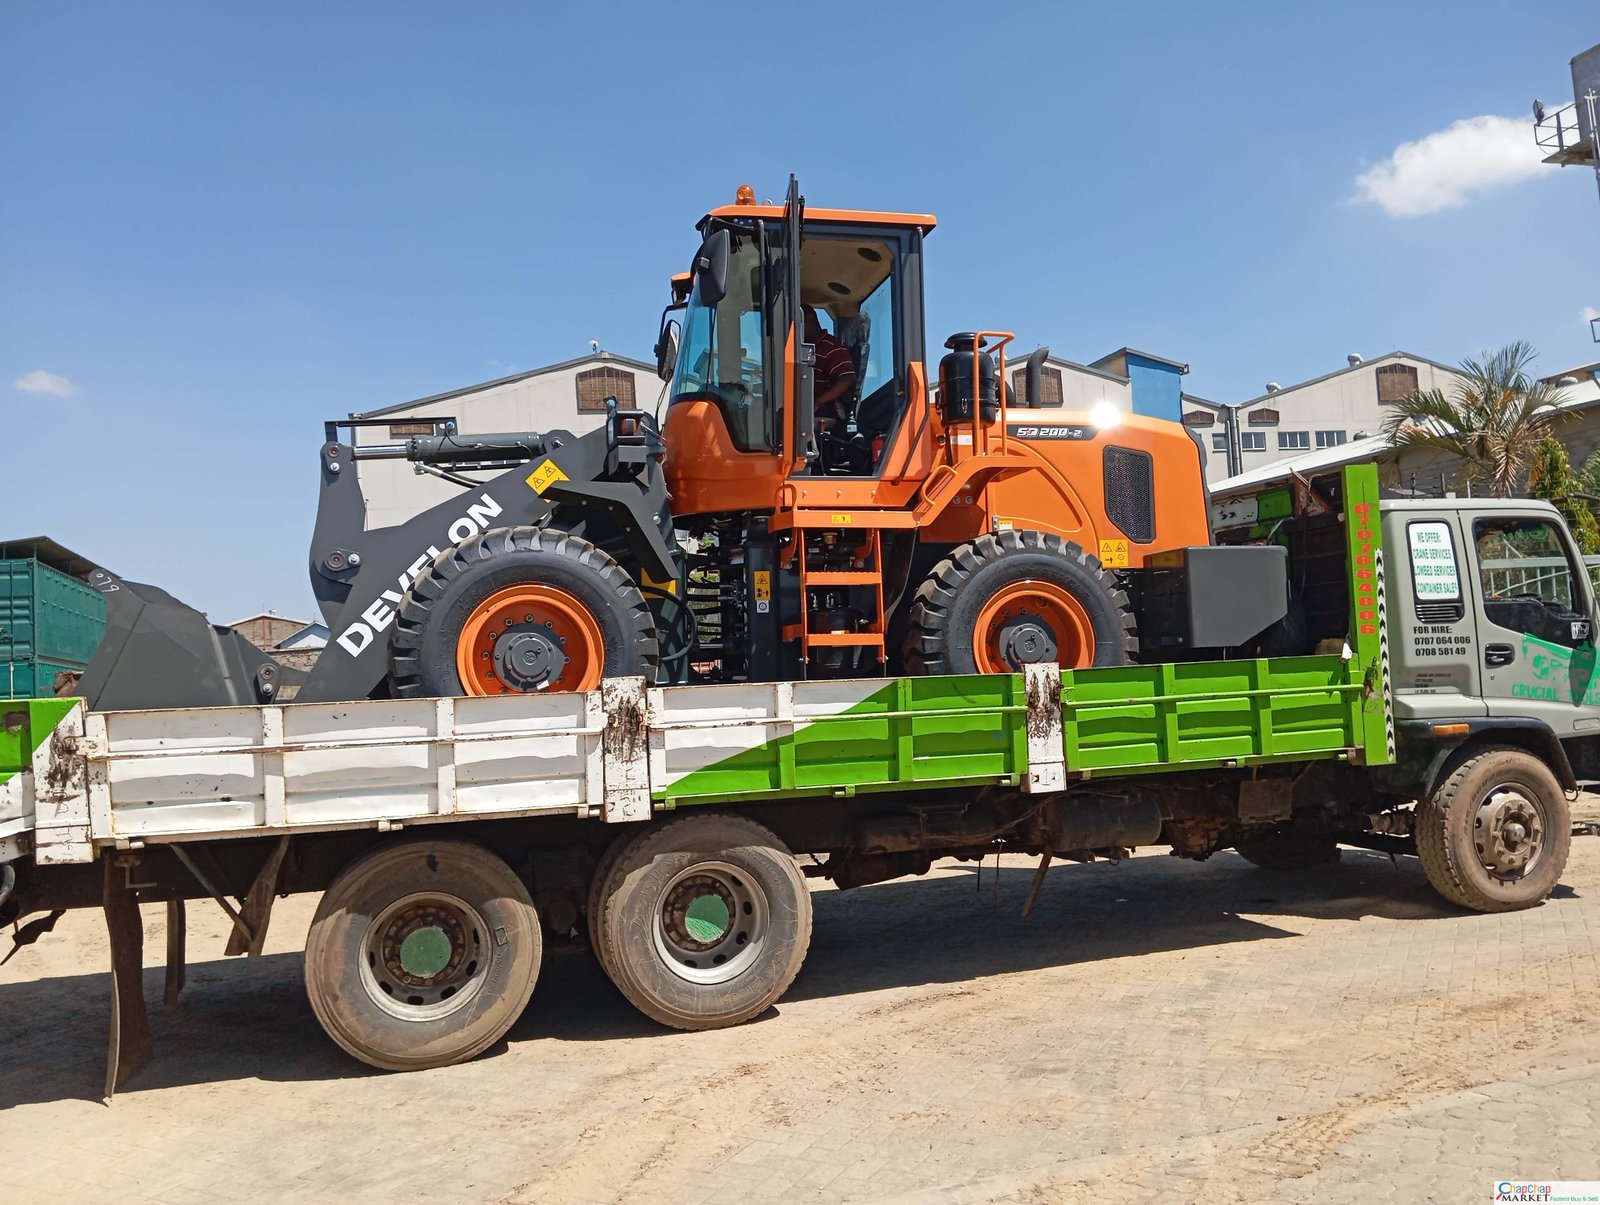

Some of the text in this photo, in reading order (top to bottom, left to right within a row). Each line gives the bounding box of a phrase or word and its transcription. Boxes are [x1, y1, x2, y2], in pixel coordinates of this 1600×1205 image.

[1416, 532, 1425, 543] WE
[1413, 549, 1452, 559] CRANE SERVICES
[336, 493, 503, 658] DEVEON
[1433, 566, 1456, 576] SERVICES
[1417, 582, 1458, 593] CONTAINER SALES
[1413, 625, 1453, 634] FOR HIRE:
[1414, 636, 1471, 645] 0707 064 006
[1415, 648, 1437, 657] 0708
[1511, 683, 1557, 700] CRUCIAL
